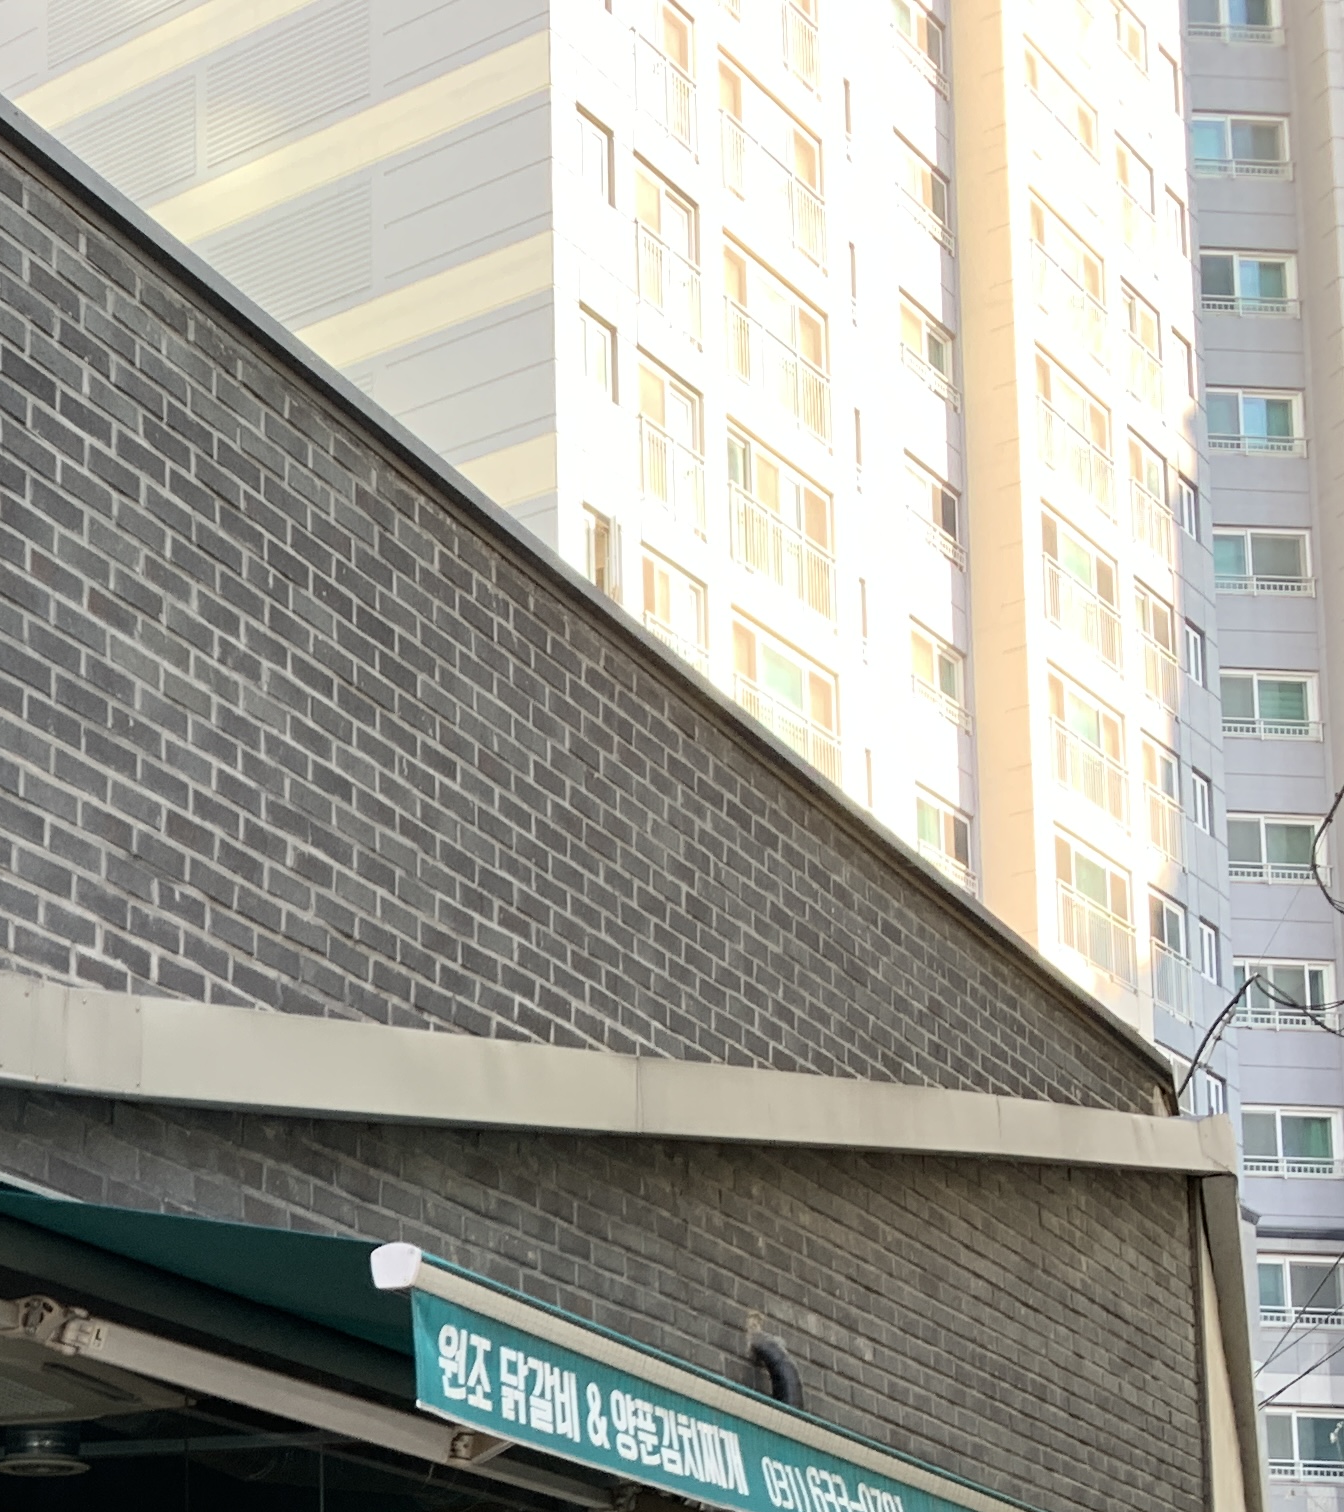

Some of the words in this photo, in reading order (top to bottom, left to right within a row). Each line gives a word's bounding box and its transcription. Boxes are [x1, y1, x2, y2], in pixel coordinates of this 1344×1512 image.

[438, 1324, 494, 1411] 원조
[498, 1344, 581, 1446] 닭갈비
[585, 1381, 611, 1450] &
[610, 1388, 750, 1498] 양푼김치찌개
